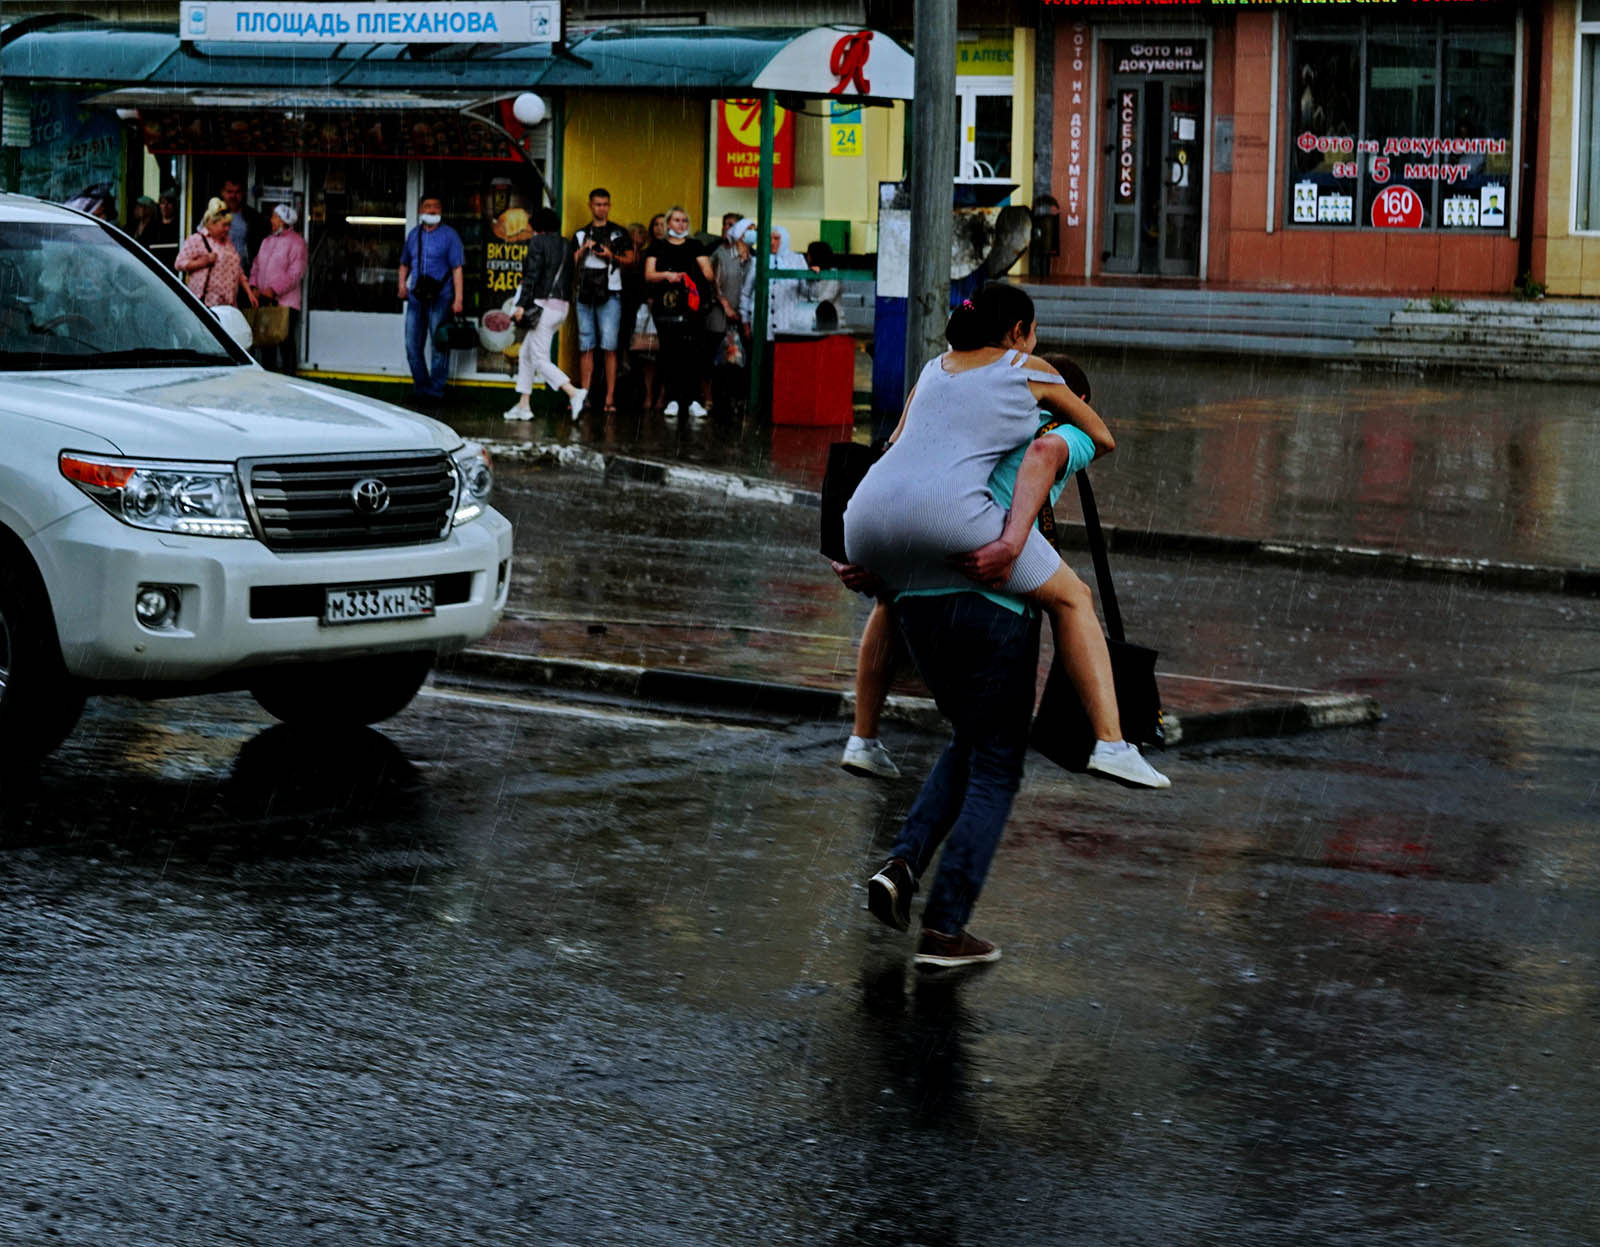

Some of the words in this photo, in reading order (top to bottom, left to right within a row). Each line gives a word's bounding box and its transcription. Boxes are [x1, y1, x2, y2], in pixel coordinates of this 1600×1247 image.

[236, 12, 350, 37] ПЛОЩАДЬ
[357, 12, 498, 33] ПЛЕХАНОВА
[972, 49, 1014, 63] АПТЕК
[1130, 44, 1171, 57] Фото
[1174, 46, 1193, 57] на
[1118, 58, 1204, 74] документы
[1071, 80, 1083, 104] НА
[837, 129, 856, 146] 24
[1119, 92, 1136, 198] КСЕРОКС
[1297, 131, 1353, 152] Фото
[1358, 138, 1379, 153] на
[1384, 136, 1506, 158] документы
[727, 151, 782, 165] НИЗКЕ
[733, 165, 761, 180] ЦЕН
[1067, 113, 1083, 227] ДОКУМЕНТЫ
[1332, 162, 1357, 178] за
[1371, 157, 1390, 184] 5
[1404, 163, 1472, 185] минут
[1380, 191, 1413, 216] 160
[1388, 214, 1407, 225] руб.
[487, 243, 529, 261] ВКУСН
[487, 269, 524, 293] ЗДЕС
[410, 584, 427, 606] 48
